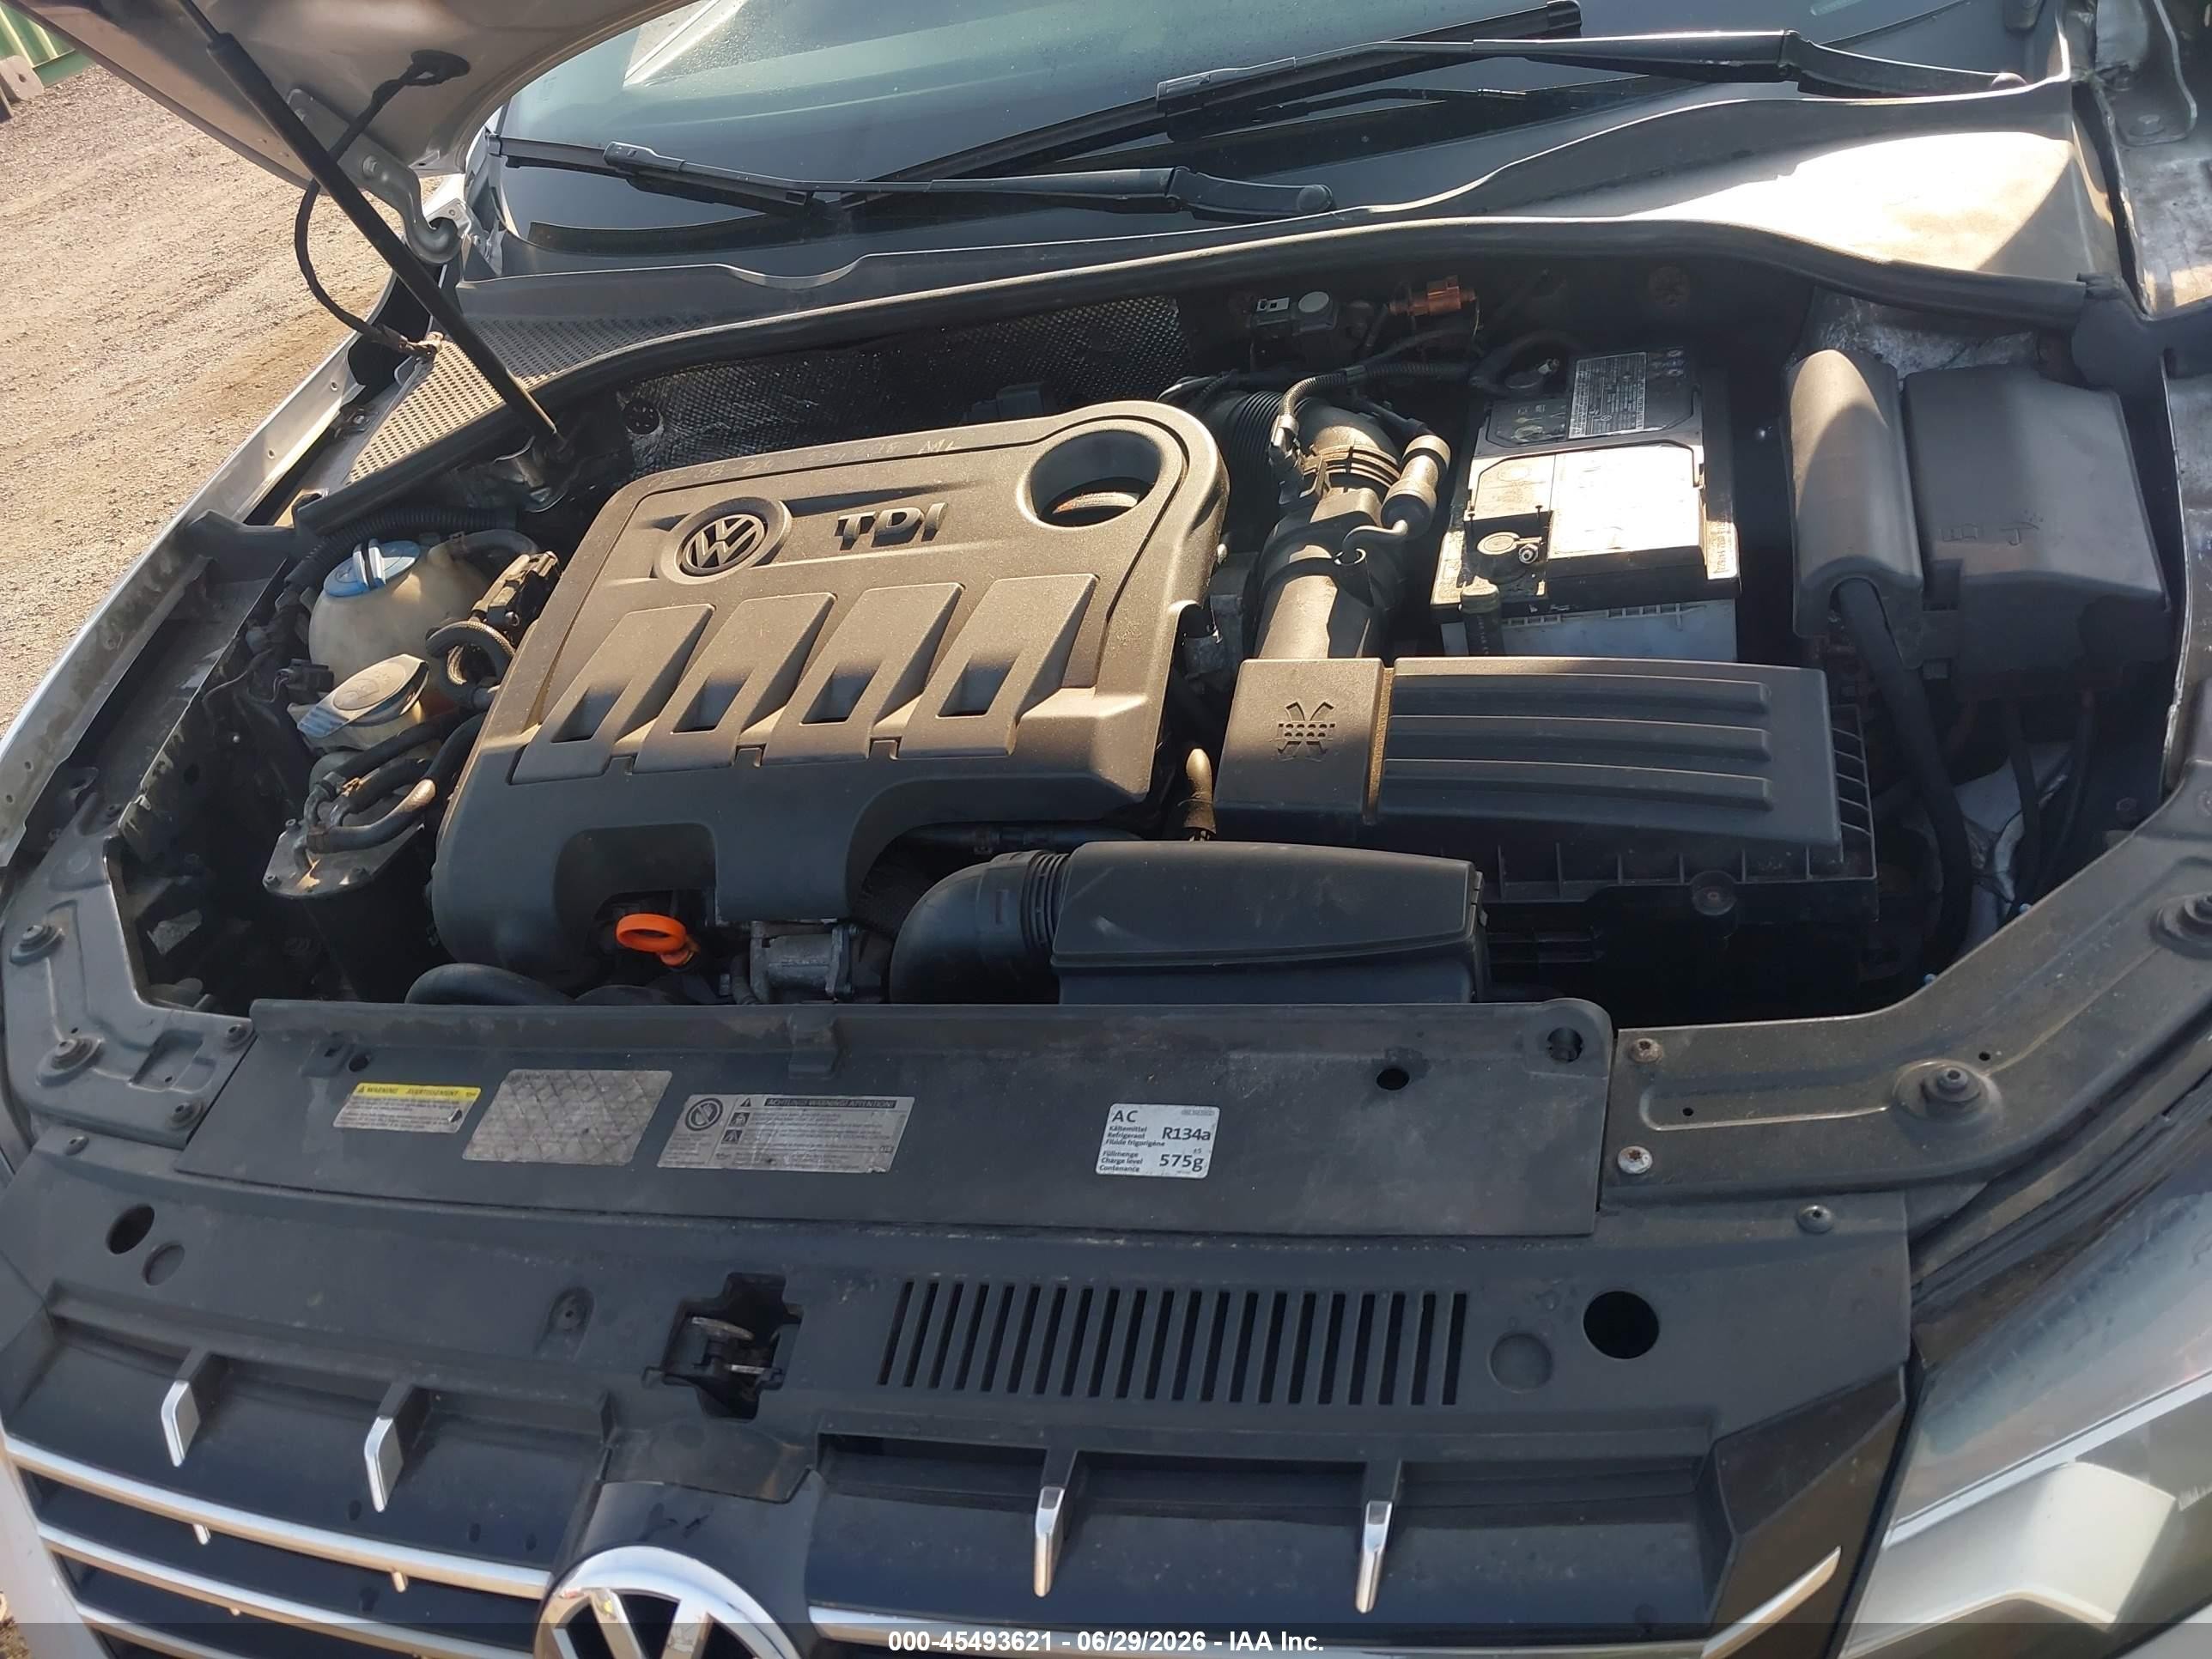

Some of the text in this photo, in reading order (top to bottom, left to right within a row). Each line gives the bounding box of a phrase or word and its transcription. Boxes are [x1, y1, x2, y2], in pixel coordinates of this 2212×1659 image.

[836, 502, 948, 550] TDI
[1112, 1109, 1138, 1122] AC
[1161, 1127, 1212, 1140] R134a
[1159, 1153, 1204, 1172] 575g
